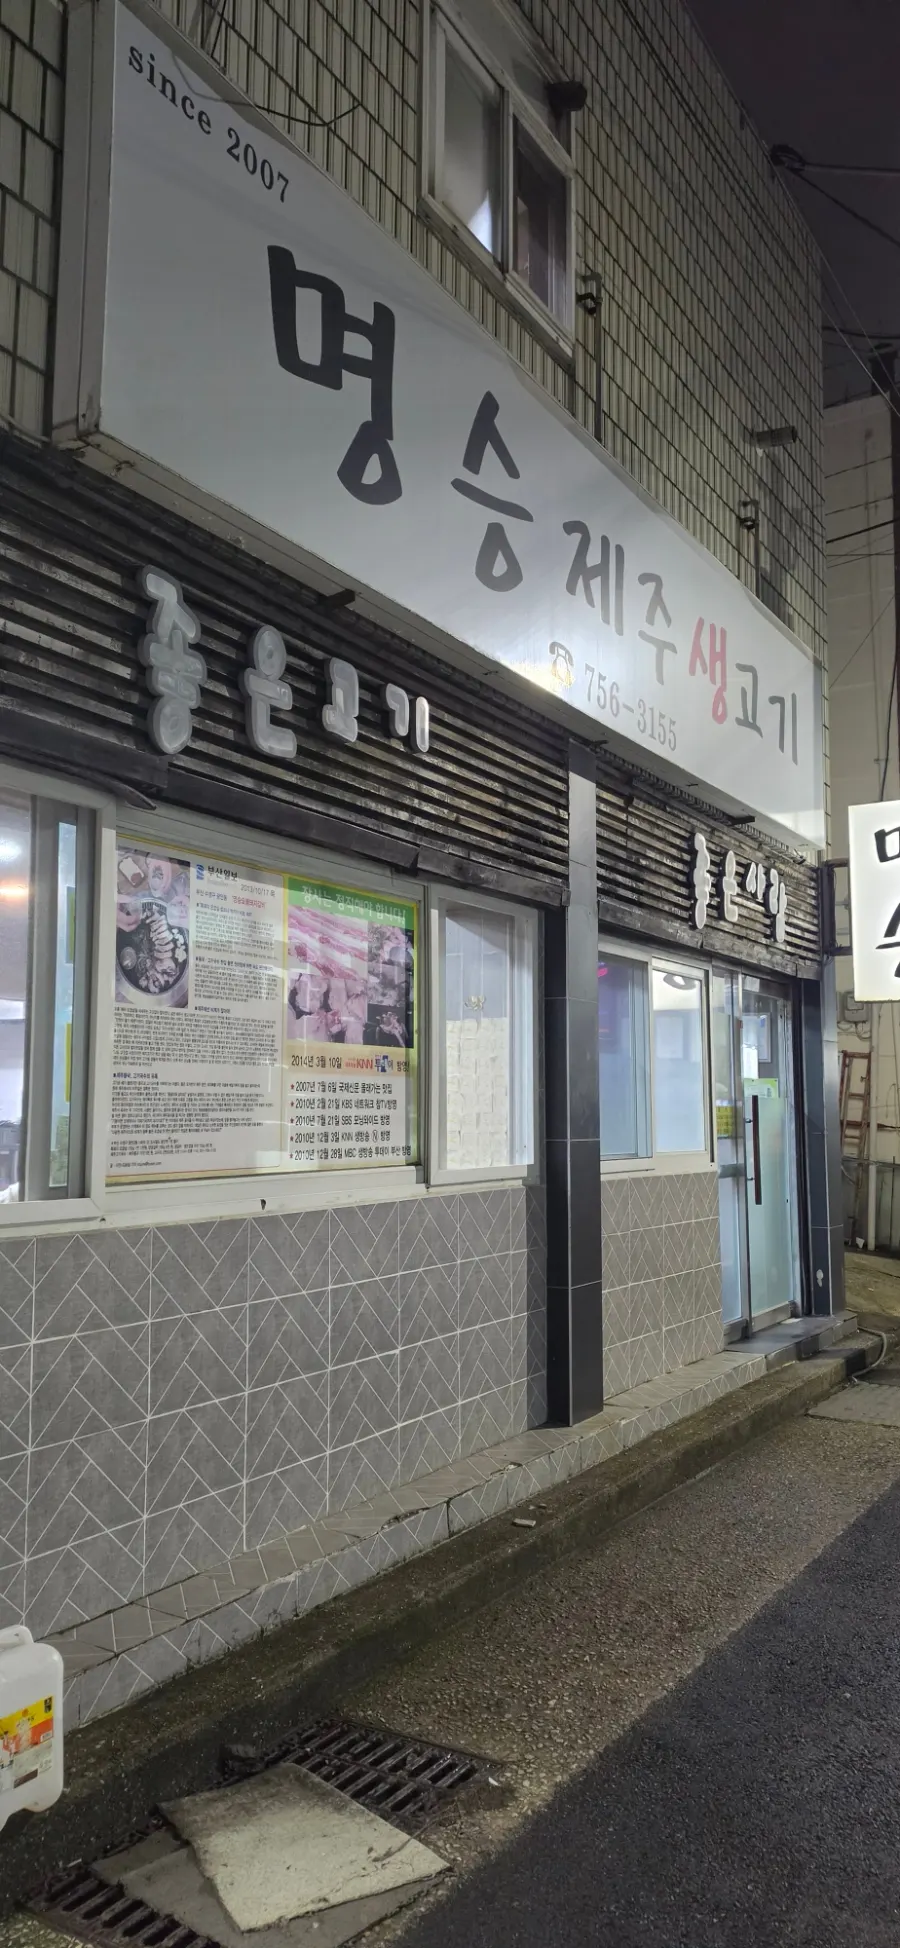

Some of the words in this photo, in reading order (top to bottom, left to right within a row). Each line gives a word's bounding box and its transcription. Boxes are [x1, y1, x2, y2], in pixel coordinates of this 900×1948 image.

[127, 41, 212, 137] since
[226, 129, 291, 204] 2007
[584, 664, 679, 752] 756-3155
[207, 865, 238, 882] 부산일보
[302, 885, 332, 908] 장사는
[291, 1054, 314, 1068] 2014년
[315, 1055, 327, 1069] 3월
[328, 1057, 342, 1070] 10일
[356, 1058, 373, 1070] KNN
[295, 1081, 316, 1093] 2007년
[317, 1081, 327, 1093] 7월
[327, 1081, 337, 1094] 6일
[338, 1082, 360, 1094] 국제신문
[382, 1083, 393, 1095] 맛집
[295, 1098, 316, 1110] 2010년
[316, 1097, 326, 1110] 2월
[327, 1098, 340, 1111] 21일
[341, 1099, 353, 1110] KBS
[354, 1098, 375, 1111] 네트워크
[295, 1115, 316, 1127] 2010년
[316, 1114, 327, 1127] 7월
[327, 1114, 340, 1127] 21일
[341, 1115, 353, 1126] SBS
[353, 1115, 380, 1126] 모닝와이드
[380, 1115, 391, 1127] 방영
[294, 1132, 315, 1144] 2010년
[316, 1131, 329, 1144] 12월
[330, 1131, 340, 1143] 3일
[341, 1132, 354, 1142] KNN
[354, 1131, 371, 1143] 생방송
[380, 1130, 391, 1142] 방영
[316, 1148, 329, 1160] 12월
[330, 1148, 343, 1160] 28일
[344, 1148, 357, 1159] MBC
[357, 1147, 374, 1159] 생방송
[374, 1146, 390, 1158] 투데이
[390, 1146, 401, 1157] 부산
[401, 1145, 412, 1157] 방영
